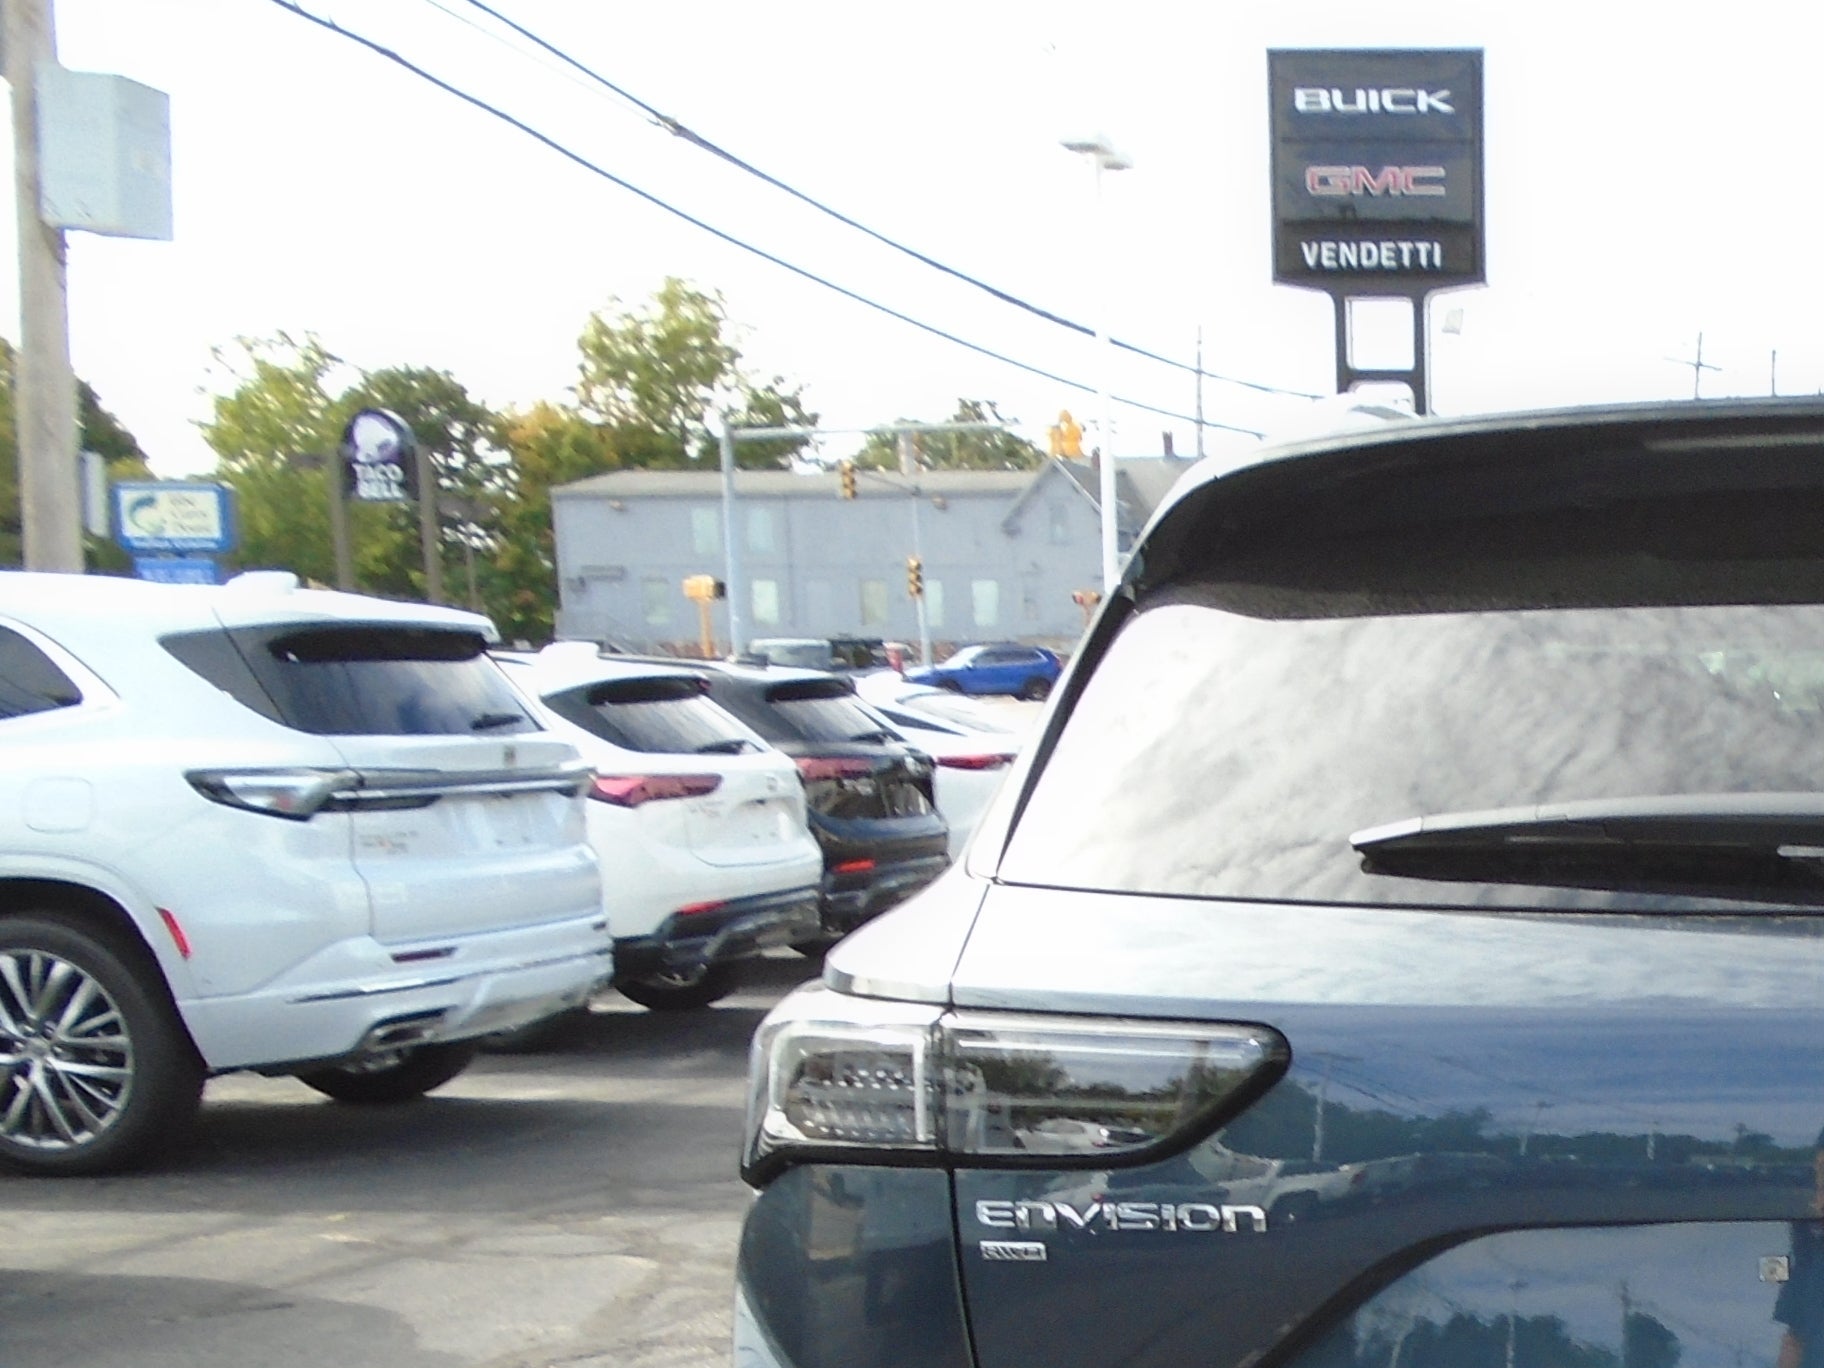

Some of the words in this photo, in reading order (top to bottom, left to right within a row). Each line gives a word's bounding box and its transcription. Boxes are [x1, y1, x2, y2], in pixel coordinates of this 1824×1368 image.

[1294, 87, 1455, 114] BUICK
[1305, 165, 1446, 196] GMC
[1301, 240, 1442, 269] VENDETTI
[352, 463, 404, 482] TACO
[976, 1198, 1267, 1235] ENVISION
